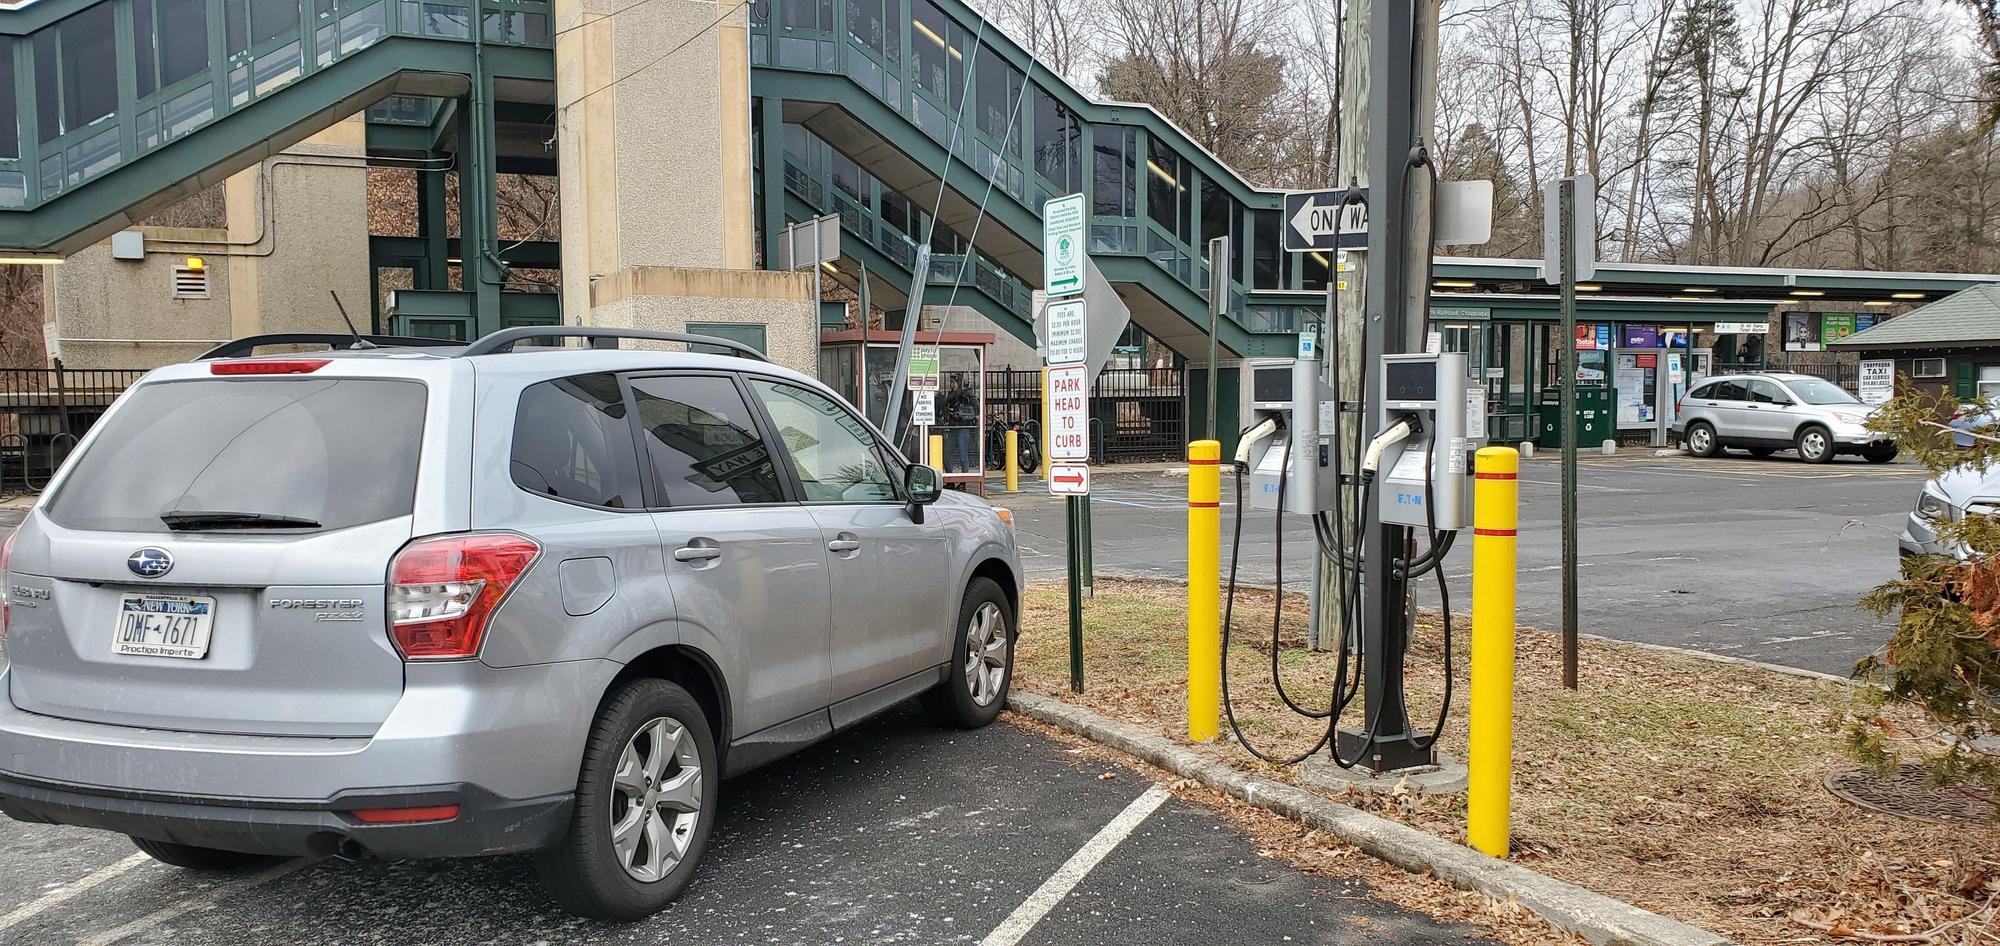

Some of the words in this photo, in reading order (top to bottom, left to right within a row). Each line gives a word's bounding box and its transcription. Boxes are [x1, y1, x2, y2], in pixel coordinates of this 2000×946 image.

[1311, 209, 1340, 231] ON
[1350, 206, 1368, 230] WA
[1054, 378, 1080, 392] PARK
[1054, 397, 1081, 411] HEAD
[1062, 416, 1074, 429] TO
[1055, 434, 1082, 448] CURB
[143, 600, 163, 612] NEW
[166, 600, 190, 614] YORK
[270, 598, 364, 609] FORESTER
[123, 613, 154, 643] DMF
[162, 615, 198, 645] 7671
